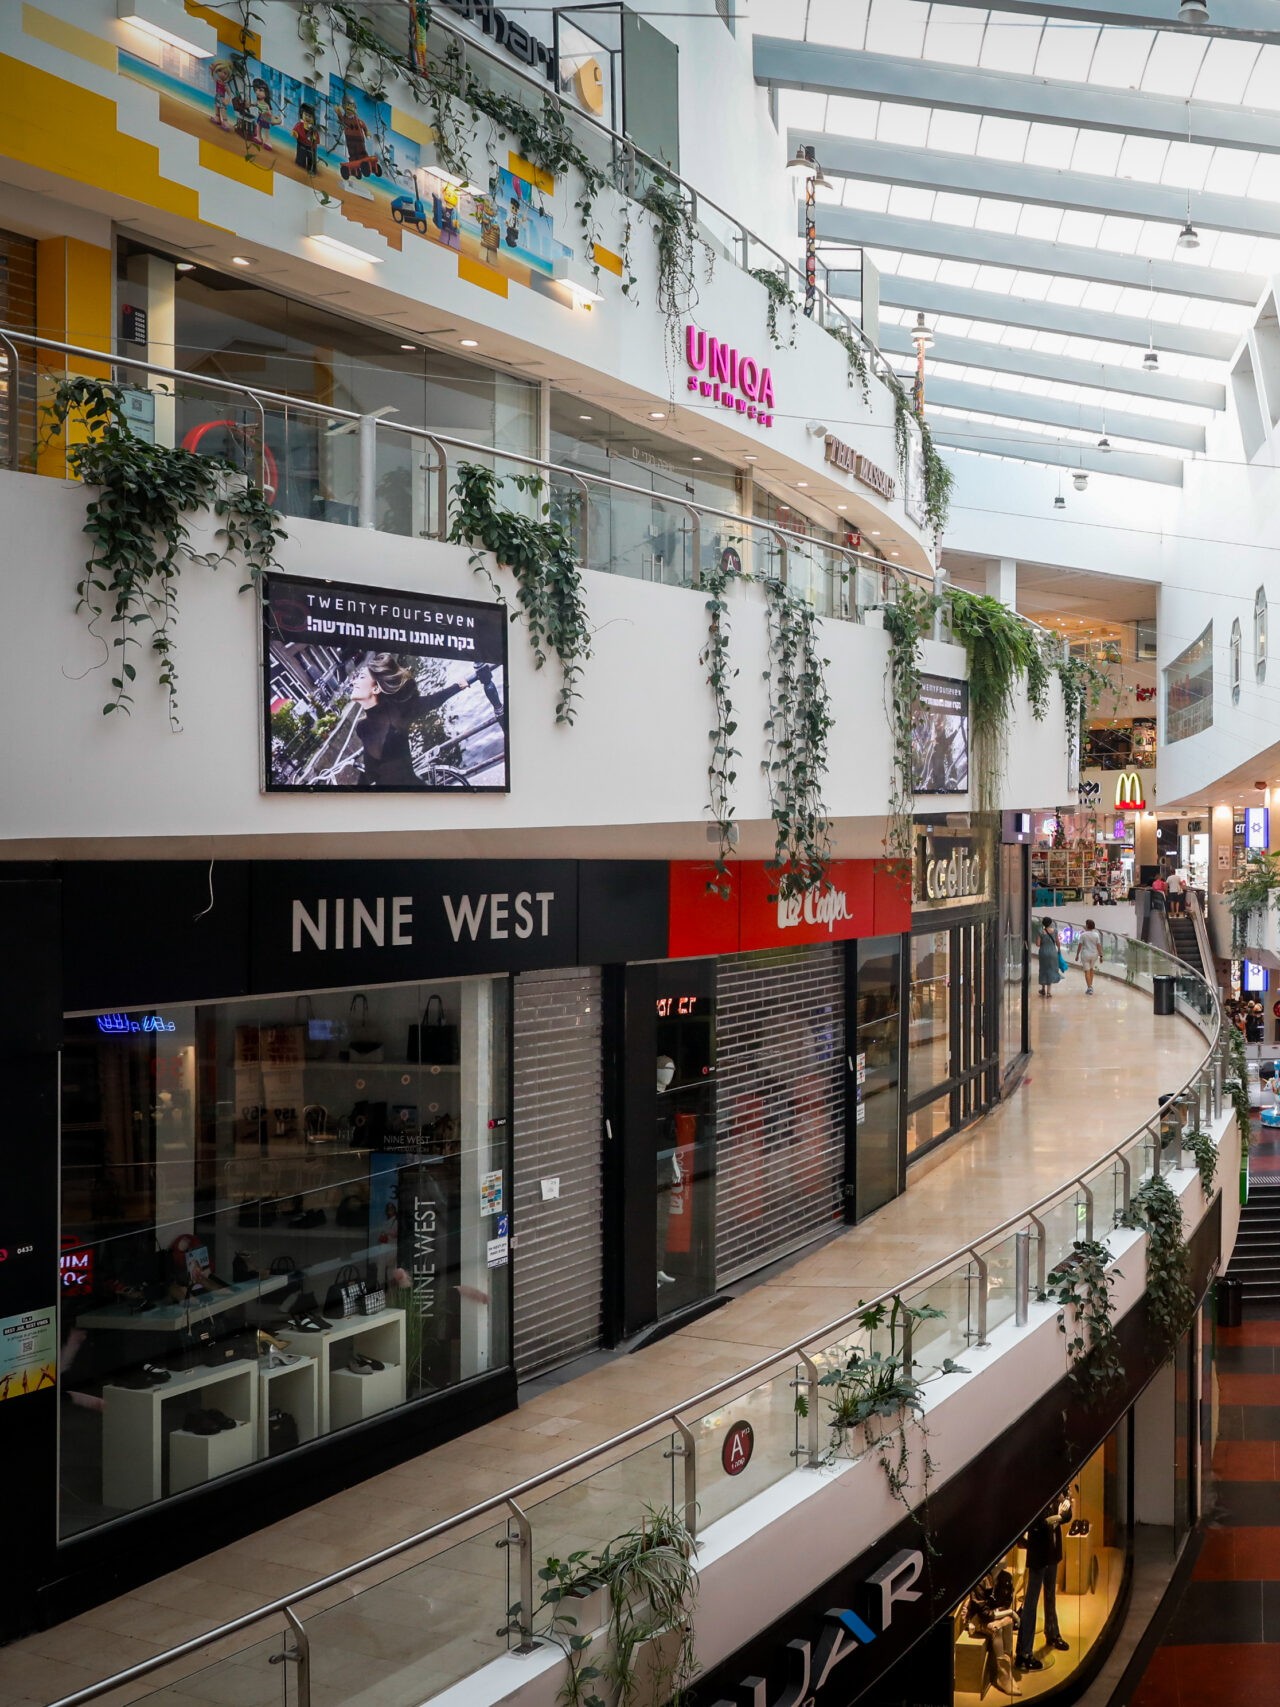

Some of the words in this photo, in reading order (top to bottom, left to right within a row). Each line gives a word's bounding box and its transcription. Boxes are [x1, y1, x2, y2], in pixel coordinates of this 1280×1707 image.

[686, 325, 776, 408] UNIQA
[825, 434, 856, 474] THAI
[854, 455, 896, 501] MASSAGE
[306, 615, 365, 637] החדשה!
[367, 625, 407, 642] בחנות
[409, 632, 444, 647] אותנו
[447, 635, 475, 651] בקרו
[292, 896, 413, 953] NINE
[442, 891, 555, 942] WEST
[413, 1196, 436, 1258] WEST
[413, 1263, 436, 1317] NINE
[731, 1434, 744, 1462] A
